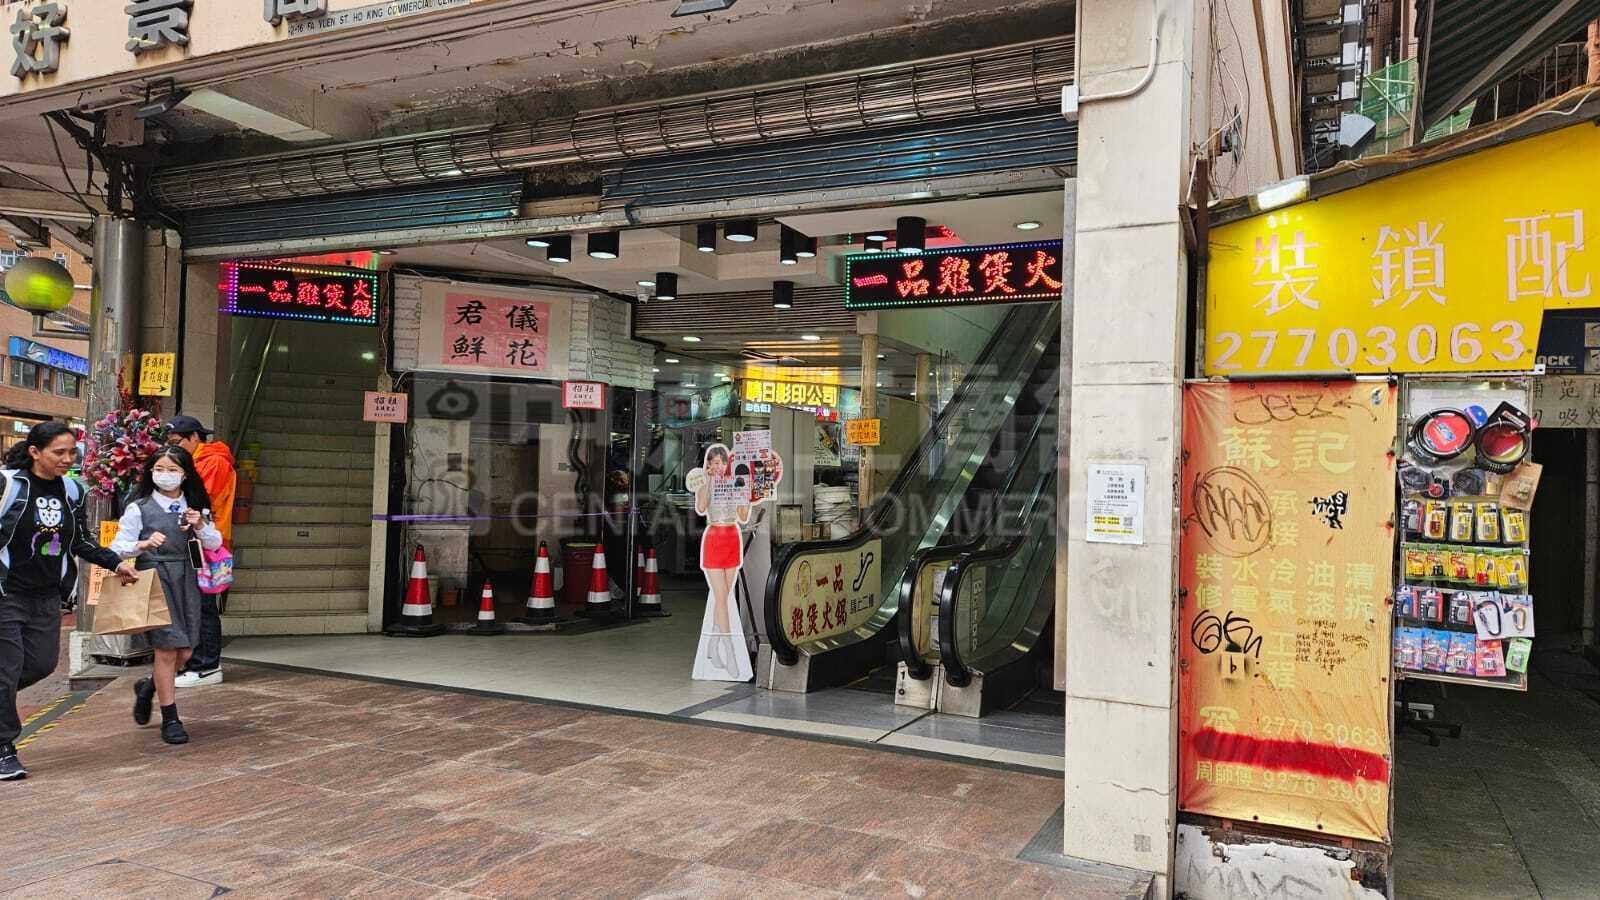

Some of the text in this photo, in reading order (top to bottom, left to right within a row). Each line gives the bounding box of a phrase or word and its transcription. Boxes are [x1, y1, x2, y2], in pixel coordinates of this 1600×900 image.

[307, 21, 315, 31] FA
[319, 17, 335, 29] YUEN
[339, 14, 349, 24] ST
[366, 8, 383, 19] KING
[454, 300, 539, 333] 君儀
[451, 334, 538, 367] 鮮花
[1214, 319, 1526, 370] 27703063
[1217, 426, 1357, 474] 蘇記
[815, 562, 844, 593] 一品
[790, 597, 848, 640] 雞煲火鍋
